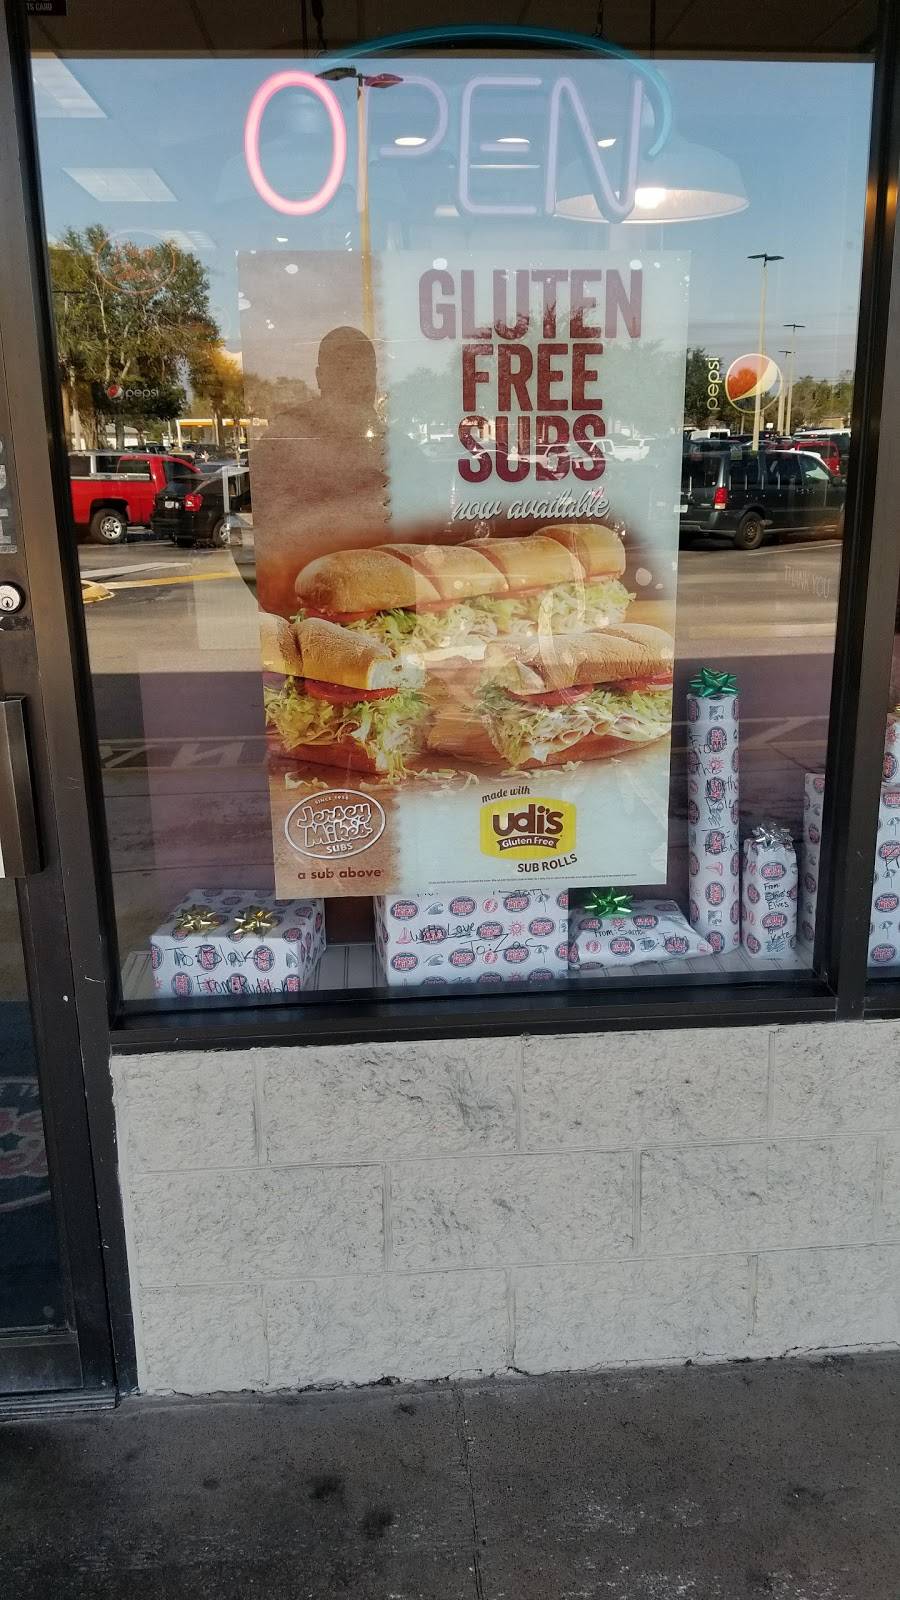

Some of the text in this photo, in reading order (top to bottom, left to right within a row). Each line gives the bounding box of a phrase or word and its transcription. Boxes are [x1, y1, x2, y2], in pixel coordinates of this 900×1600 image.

[244, 70, 644, 223] OPEN
[418, 268, 643, 340] GLUTEN
[462, 343, 604, 412] FREE
[705, 357, 723, 411] pepsi
[125, 386, 159, 400] pepsi
[457, 414, 606, 483] SUBS
[453, 486, 611, 520] now available
[481, 785, 531, 804] made with
[297, 803, 372, 828] Jersey
[493, 803, 564, 836] udi's
[326, 842, 354, 854] SUBS
[501, 837, 555, 848] Gluten Free
[297, 866, 382, 880] a sub above
[517, 853, 578, 873] SUB ROLLS
[767, 900, 790, 911] Elves
[446, 921, 476, 938] Love
[770, 930, 793, 942] Kate
